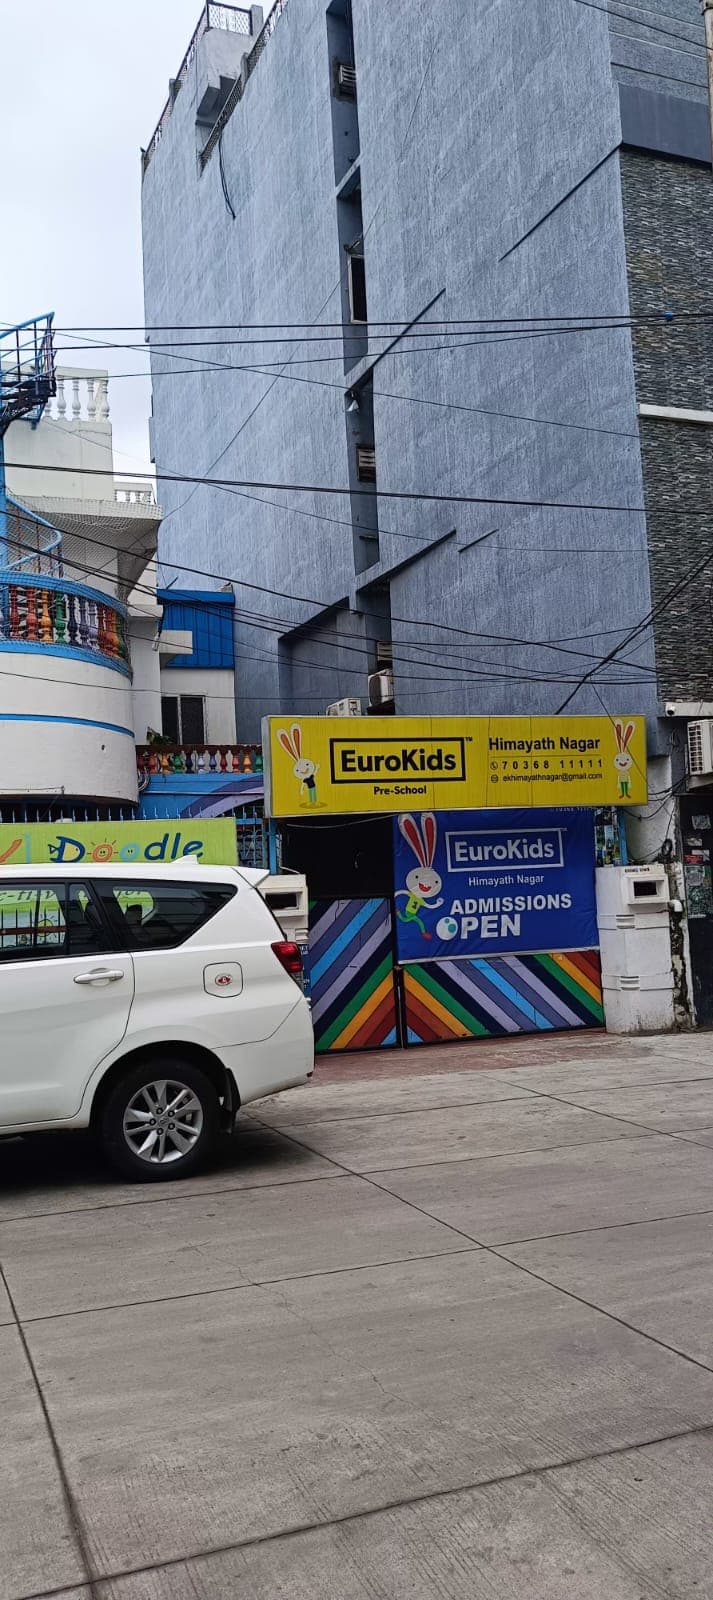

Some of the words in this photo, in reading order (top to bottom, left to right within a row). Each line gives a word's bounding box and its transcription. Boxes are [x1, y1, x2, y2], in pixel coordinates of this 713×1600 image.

[489, 737, 555, 753] Himayath
[560, 737, 601, 752] Nagar
[341, 748, 457, 772] EuroKids
[373, 785, 427, 795] Pre-School
[48, 832, 204, 864] Doodle
[454, 838, 554, 862] EuroKids
[468, 875, 514, 887] Himayath
[516, 874, 544, 886] Nagar
[450, 893, 572, 916] ADMISSIONS
[436, 913, 521, 941] OPEN
